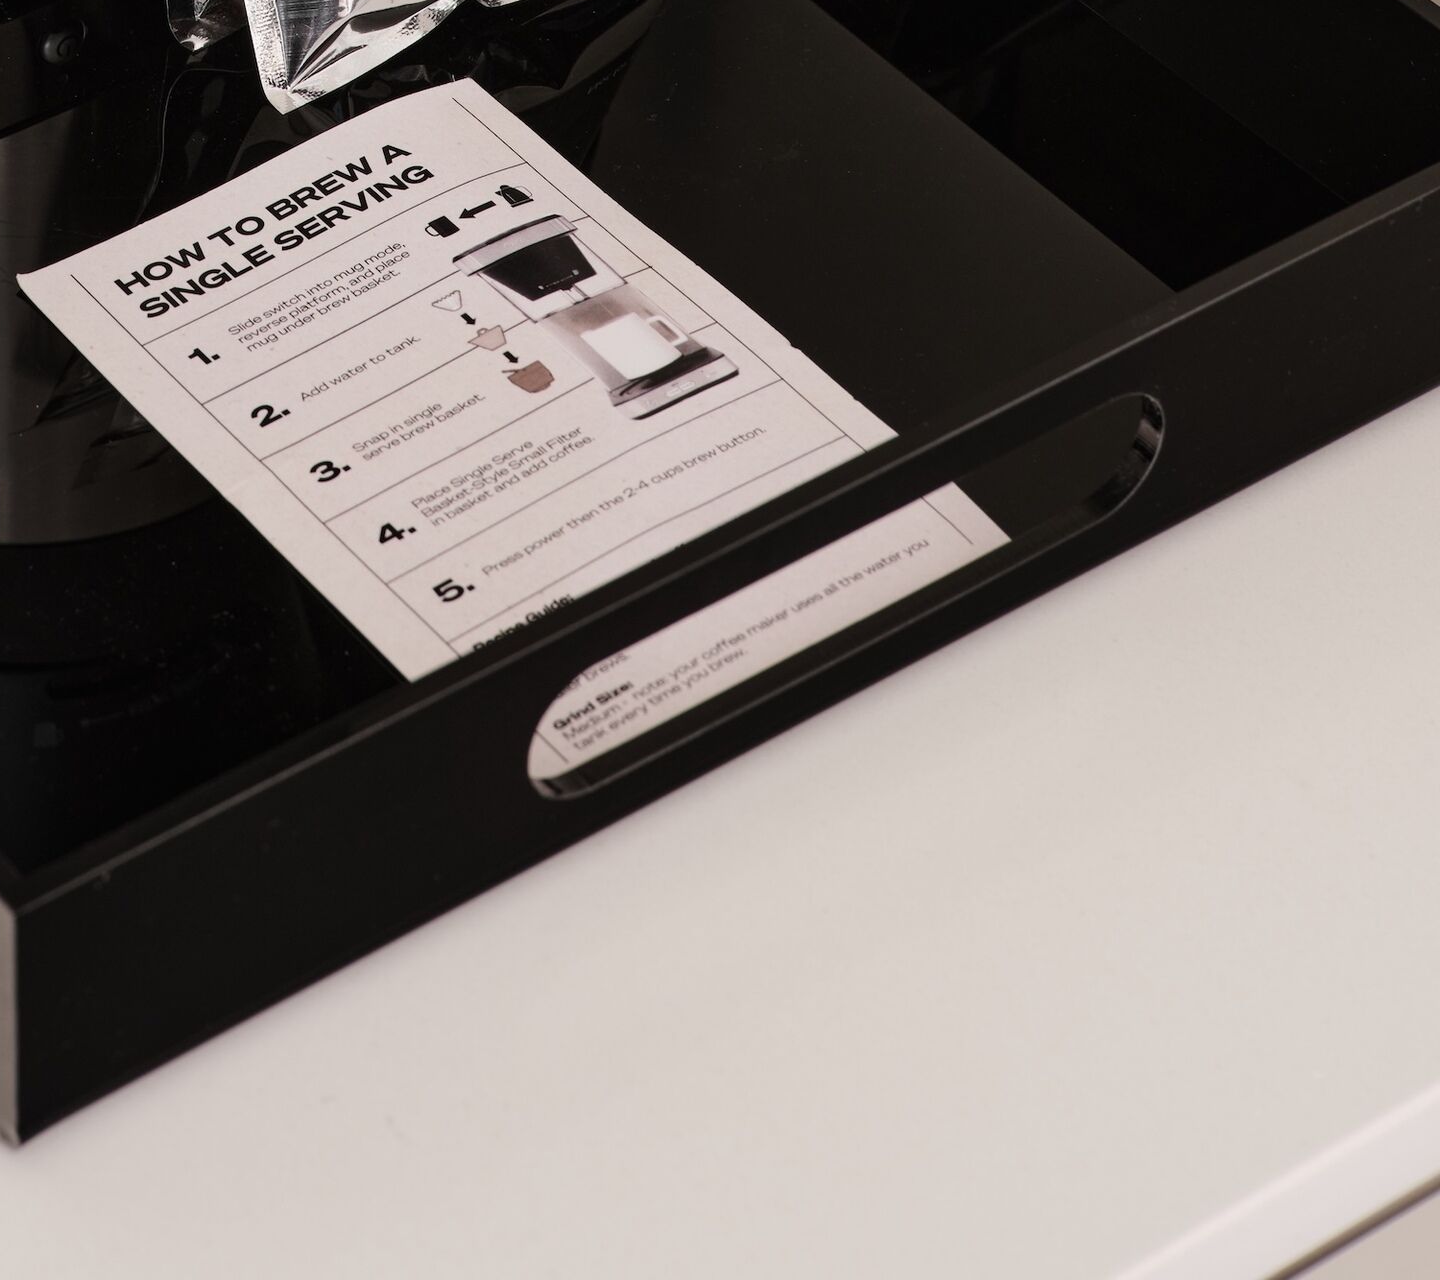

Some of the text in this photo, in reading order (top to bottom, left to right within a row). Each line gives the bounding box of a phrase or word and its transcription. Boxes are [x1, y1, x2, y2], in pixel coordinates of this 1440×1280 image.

[114, 144, 412, 296] HOW TO BREW A
[139, 165, 435, 318] SINGLE SERVING
[228, 241, 407, 336] Slide switch into mug mode,
[238, 251, 411, 344] reverse platform, and place
[246, 270, 402, 353] mug under brew basket.
[188, 347, 221, 365] 1.
[300, 333, 421, 402] Add water to tank.
[250, 404, 292, 428] 2.
[352, 402, 443, 455] Snap in single
[362, 392, 486, 461] serve brew basket.
[309, 460, 352, 483] 3.
[410, 440, 535, 509] Place Single Serve
[420, 426, 584, 518] Basket-Style Small Filter
[431, 435, 596, 528] in basket and add coffee.
[481, 425, 768, 576] Press power then the 2-4 cups brew button.
[378, 522, 418, 545] 4.
[432, 578, 476, 603] 5.
[562, 704, 622, 741] Medium
[670, 658, 700, 681] your
[701, 633, 747, 661] coffee
[747, 608, 790, 637] maker
[791, 592, 824, 614] uses
[823, 582, 841, 597] all
[838, 571, 864, 589] the
[864, 550, 903, 576] water
[902, 538, 931, 558] you
[553, 702, 595, 730] Grind
[595, 680, 635, 706] Size:
[572, 647, 749, 752] tank every time you brew.
